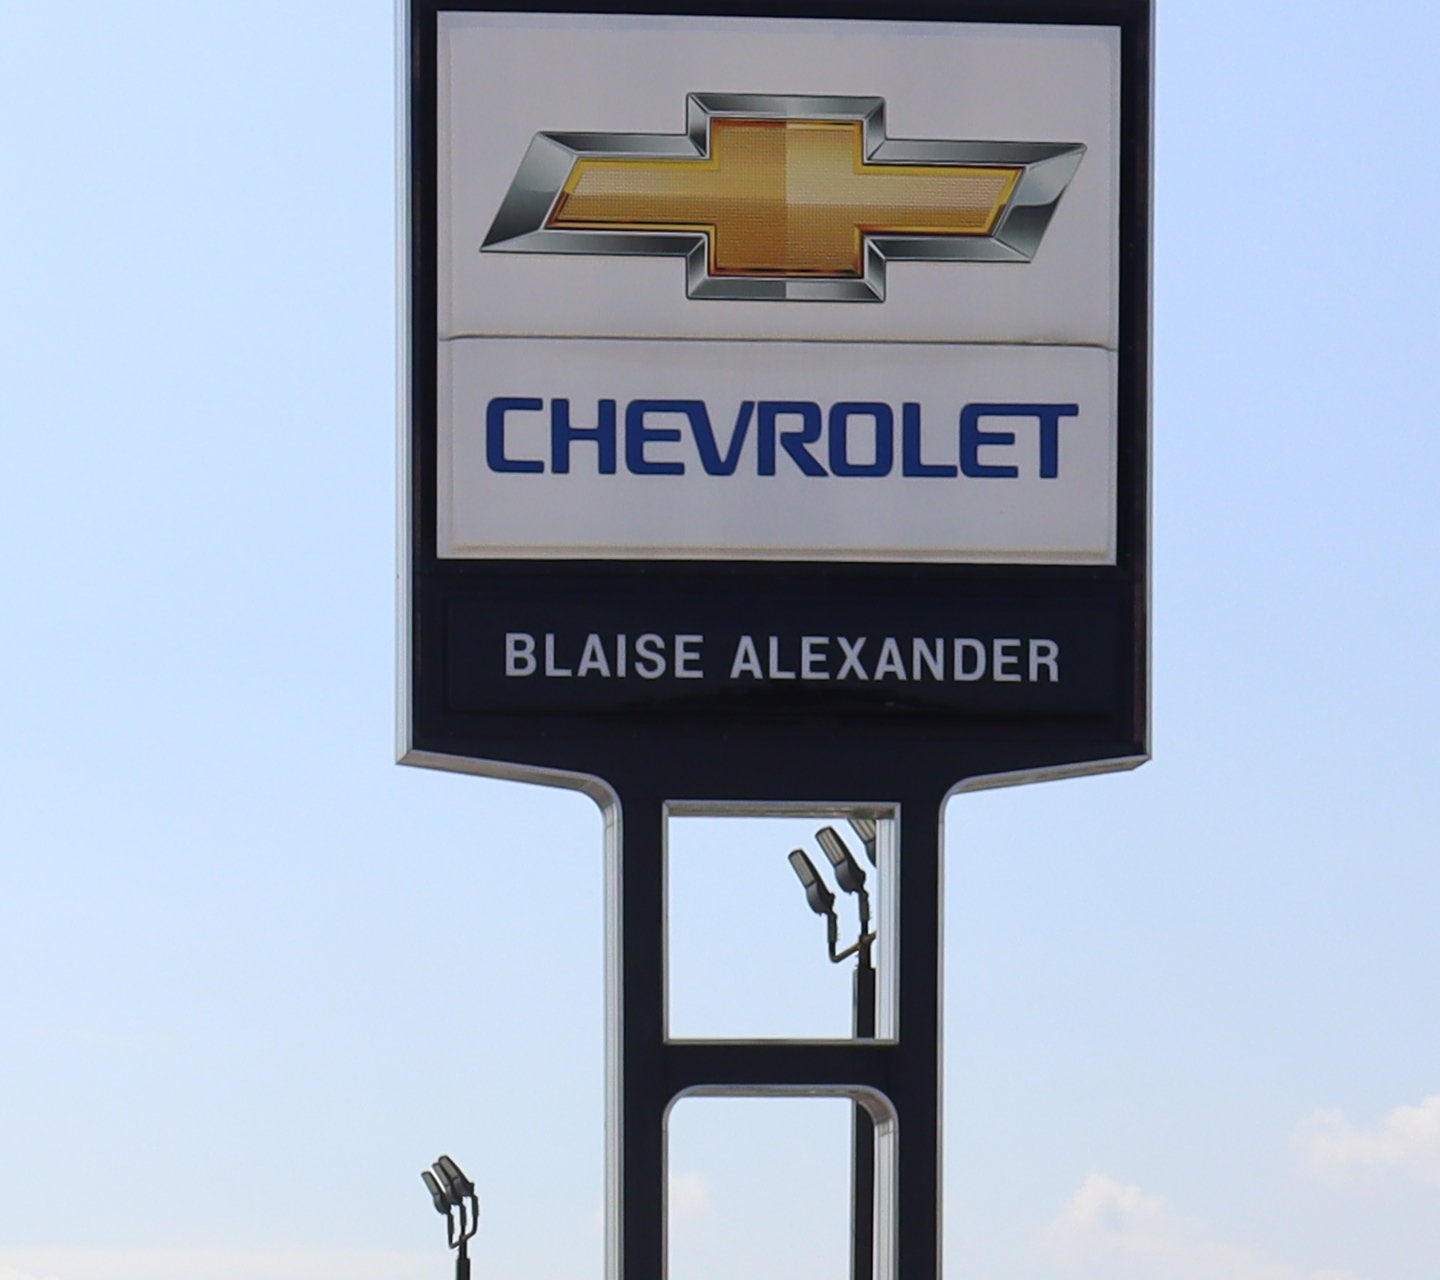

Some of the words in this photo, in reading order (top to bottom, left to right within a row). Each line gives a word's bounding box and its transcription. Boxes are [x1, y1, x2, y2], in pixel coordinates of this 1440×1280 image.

[485, 396, 1079, 479] CHEVROLET
[504, 633, 704, 679] BLAISE
[730, 635, 1061, 683] ALEXANDER
